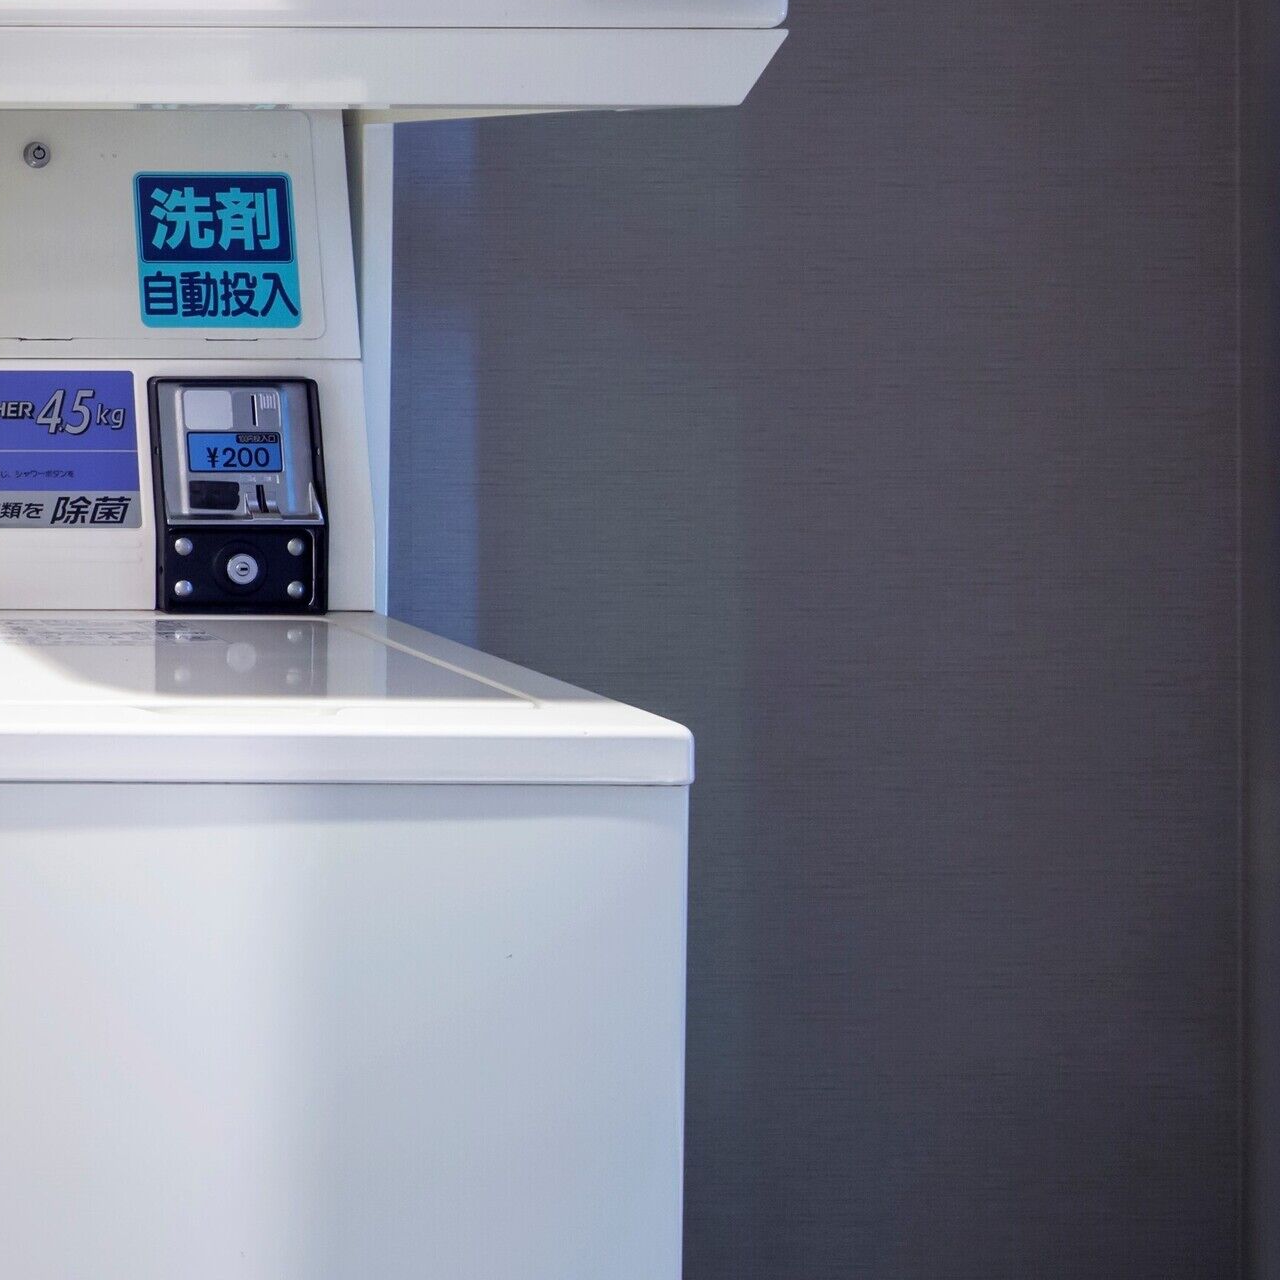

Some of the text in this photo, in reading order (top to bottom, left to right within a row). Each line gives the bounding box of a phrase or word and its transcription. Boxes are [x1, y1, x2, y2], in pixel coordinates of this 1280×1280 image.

[151, 187, 279, 251] 洗剤
[144, 272, 299, 317] 自動投入
[96, 404, 124, 429] kg
[207, 447, 269, 468] ¥200
[50, 496, 131, 524] 除菌
